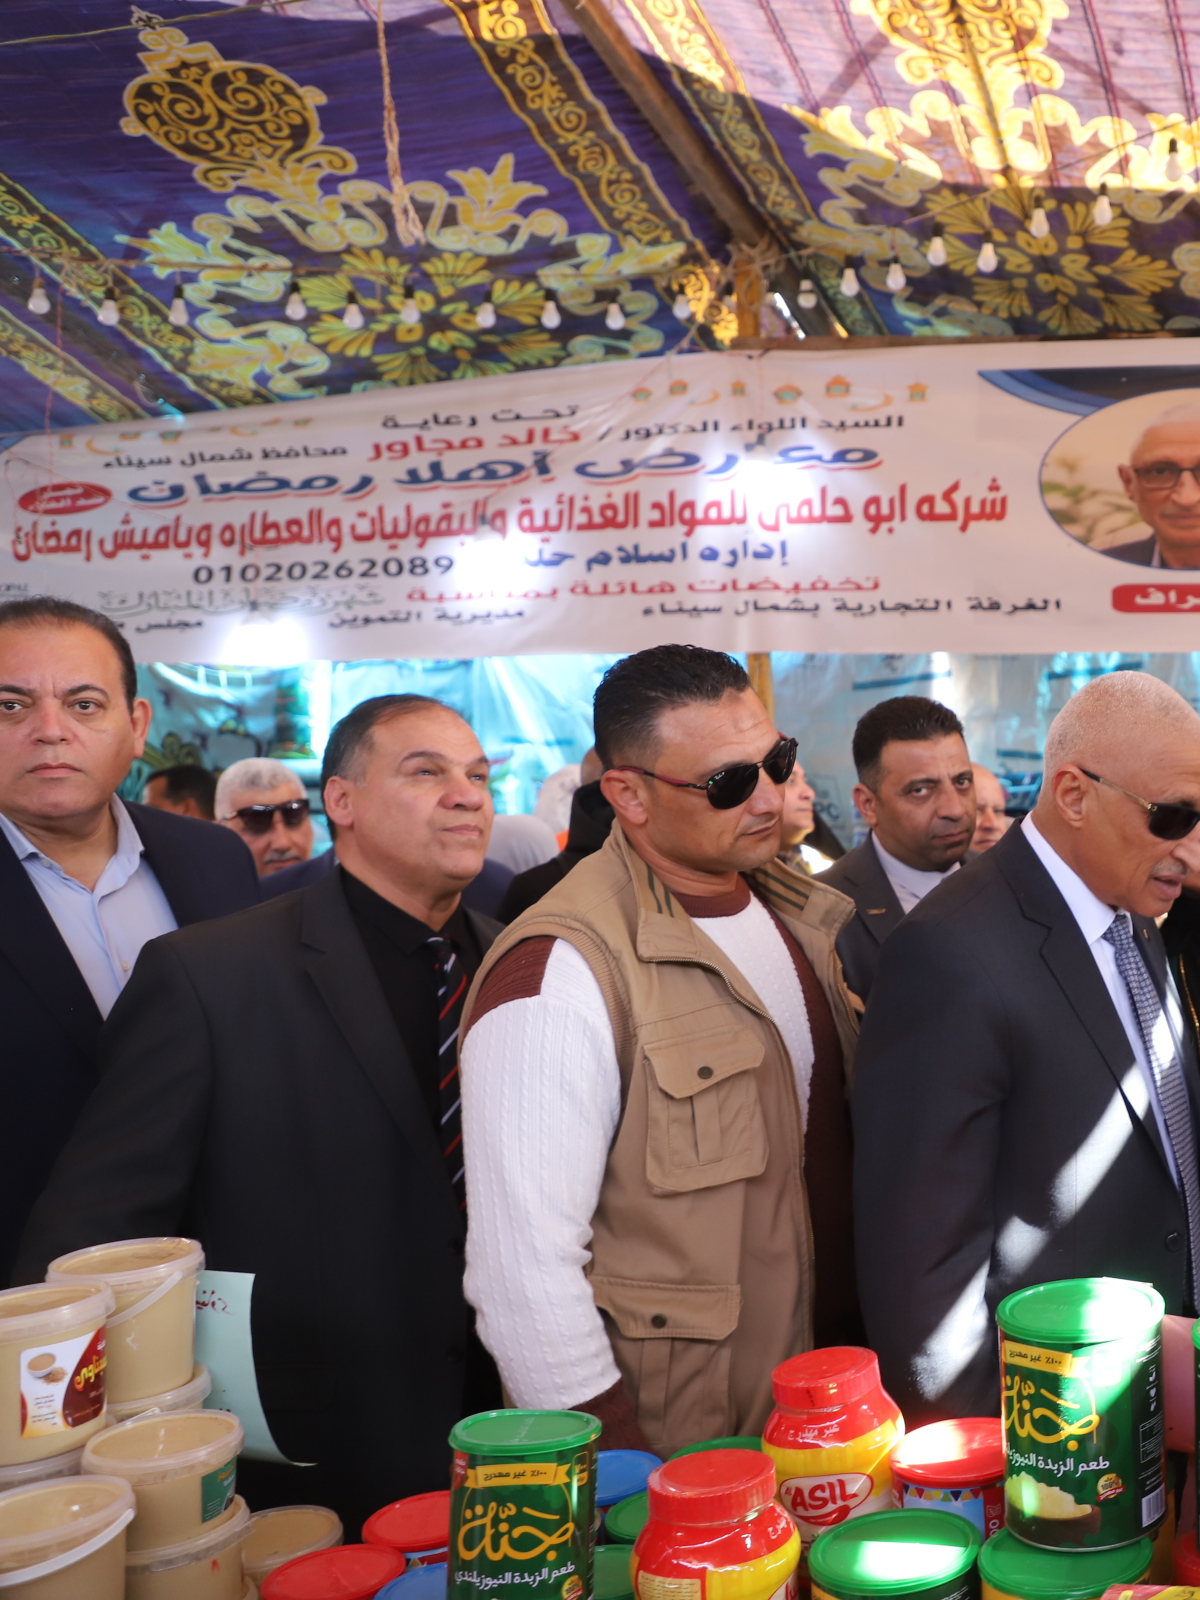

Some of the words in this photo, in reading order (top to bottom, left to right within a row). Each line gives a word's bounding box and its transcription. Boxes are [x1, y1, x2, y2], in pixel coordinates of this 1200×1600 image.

[381, 411, 478, 431] رعاية
[491, 405, 580, 423] تحت
[817, 414, 904, 431] السيد
[730, 417, 807, 434] اللواء
[496, 425, 582, 448] خالد
[180, 446, 254, 469] شمال
[260, 444, 348, 462] محافظ
[366, 433, 484, 462] مجاور
[102, 452, 173, 469] سيناء
[126, 467, 374, 505] رمضان
[647, 488, 748, 538] للمواد
[866, 481, 908, 536] ابو
[912, 477, 1009, 534] شركه
[516, 490, 640, 544] الغذائية
[12, 519, 93, 563] رمضان
[99, 511, 213, 562] وياميش
[219, 507, 343, 559] والعطاره
[585, 542, 689, 573] اسلام
[193, 555, 455, 585] 01020262089
[569, 578, 677, 599] هائلة
[687, 576, 881, 595] تخفيضات
[433, 607, 525, 625] مديرية
[642, 602, 723, 618] سيناء
[734, 601, 819, 619] بشمال
[834, 597, 952, 617] التجارية
[966, 597, 1061, 617] الغرفة
[134, 618, 204, 634] مجلس
[328, 609, 422, 629] التموين
[1029, 1353, 1042, 1363] غير
[483, 1472, 511, 1482] مهدرج
[513, 1470, 528, 1480] غير
[1037, 1456, 1075, 1478] الزبدة
[1075, 1456, 1110, 1477] طعم
[783, 1485, 794, 1497] AL
[790, 1478, 859, 1513] ASIL
[454, 1570, 513, 1591] النيوزيلندي
[513, 1567, 550, 1588] الزبدة
[549, 1561, 577, 1584] طعم
